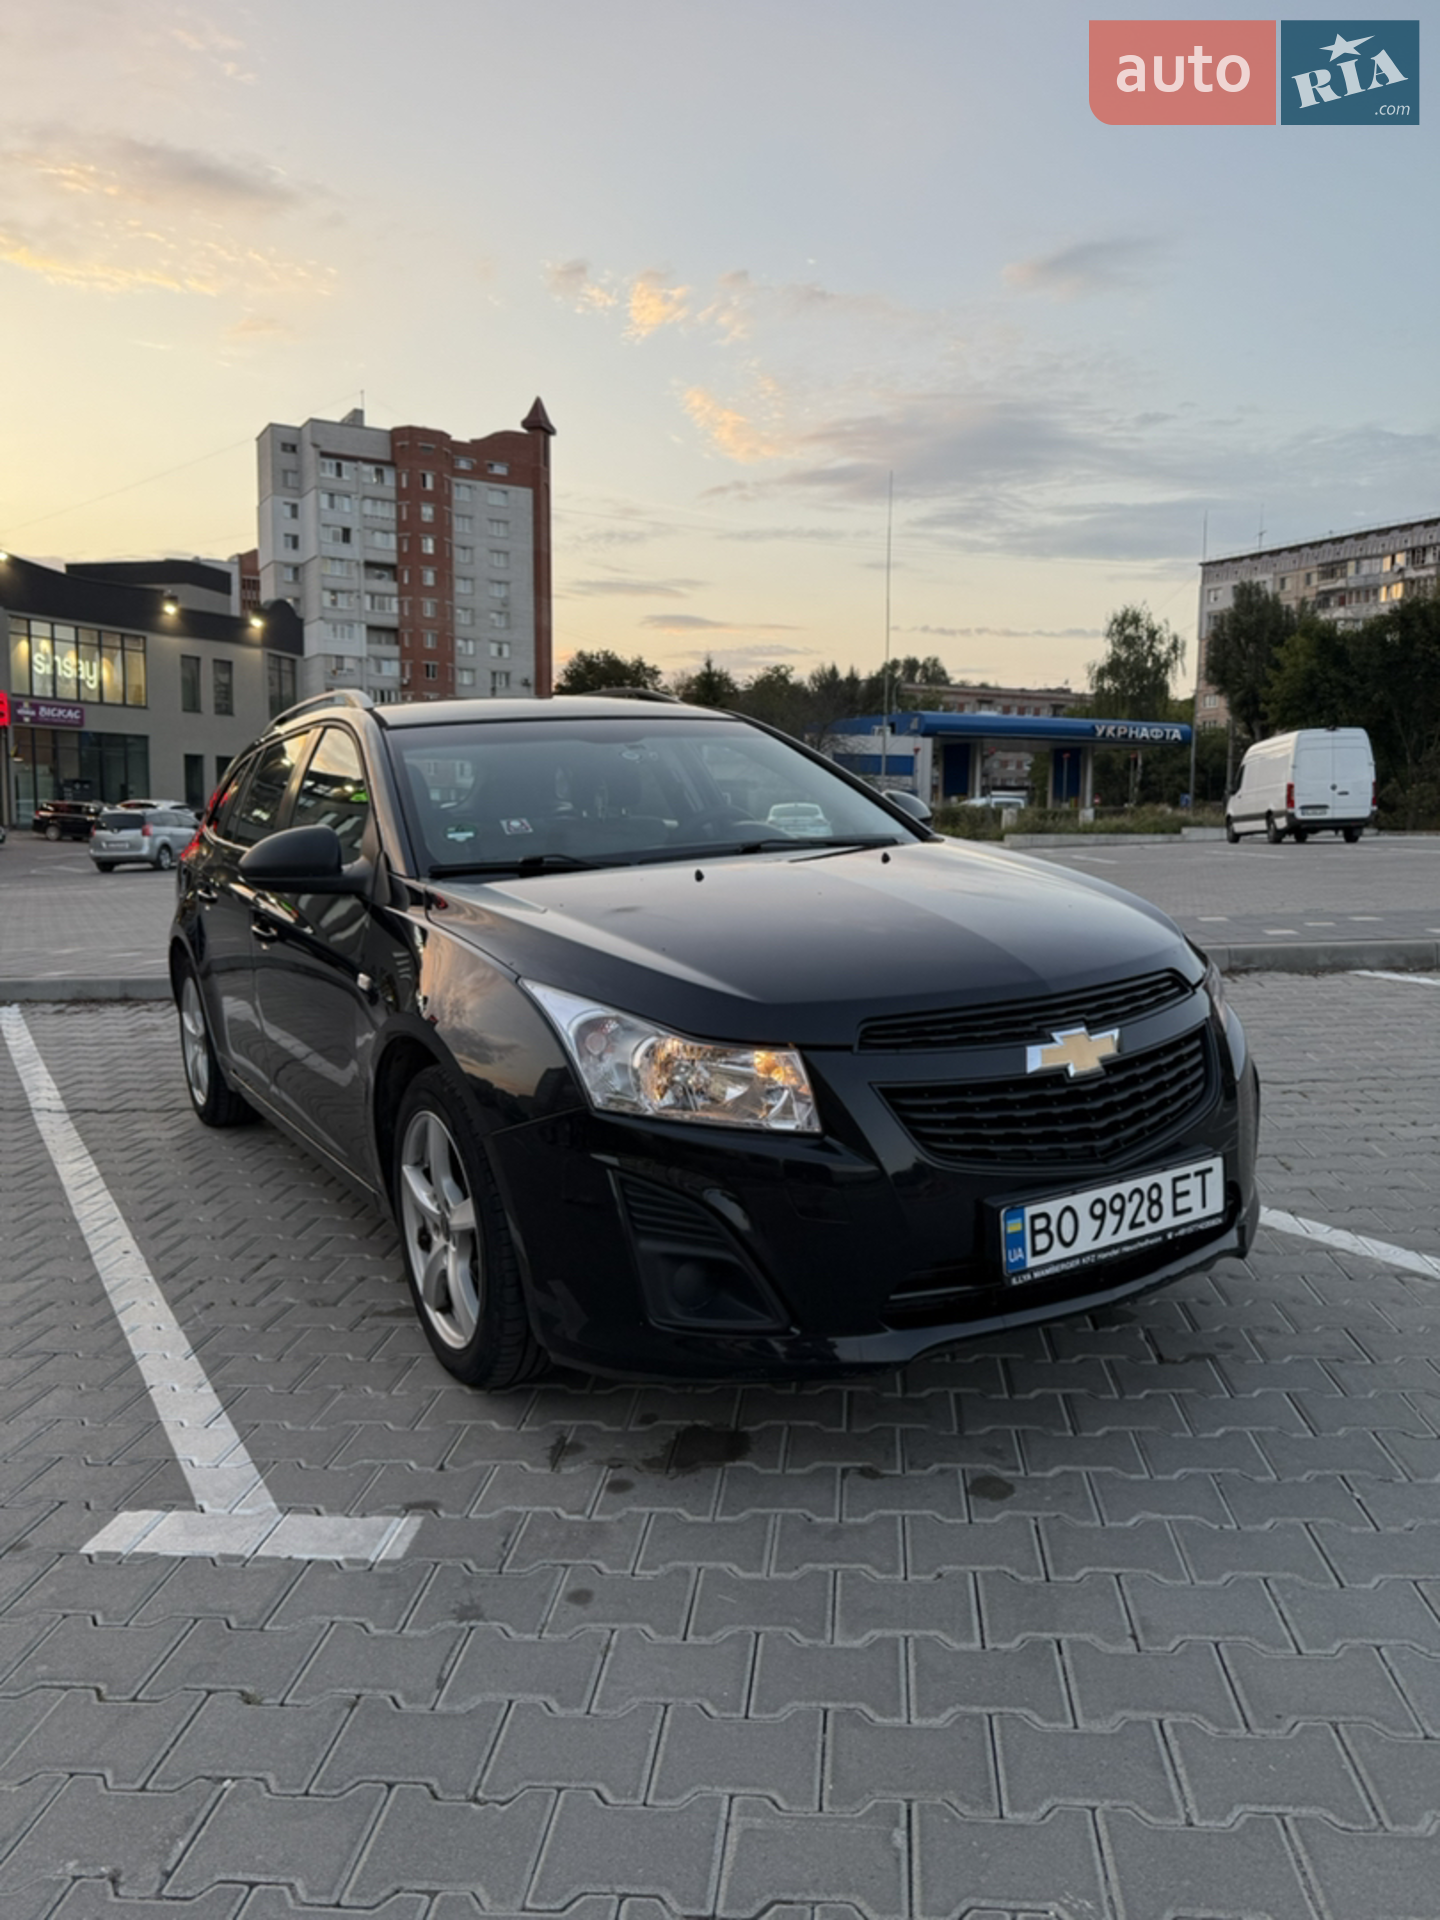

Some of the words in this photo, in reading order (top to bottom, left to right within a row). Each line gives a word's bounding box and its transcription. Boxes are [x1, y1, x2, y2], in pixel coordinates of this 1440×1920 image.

[32, 651, 98, 690] sinsay
[1094, 724, 1182, 741] УКРНАФТА
[1029, 1205, 1079, 1258] BO
[1089, 1182, 1164, 1242] 9928
[1172, 1166, 1214, 1218] ET
[1008, 1247, 1025, 1263] UA
